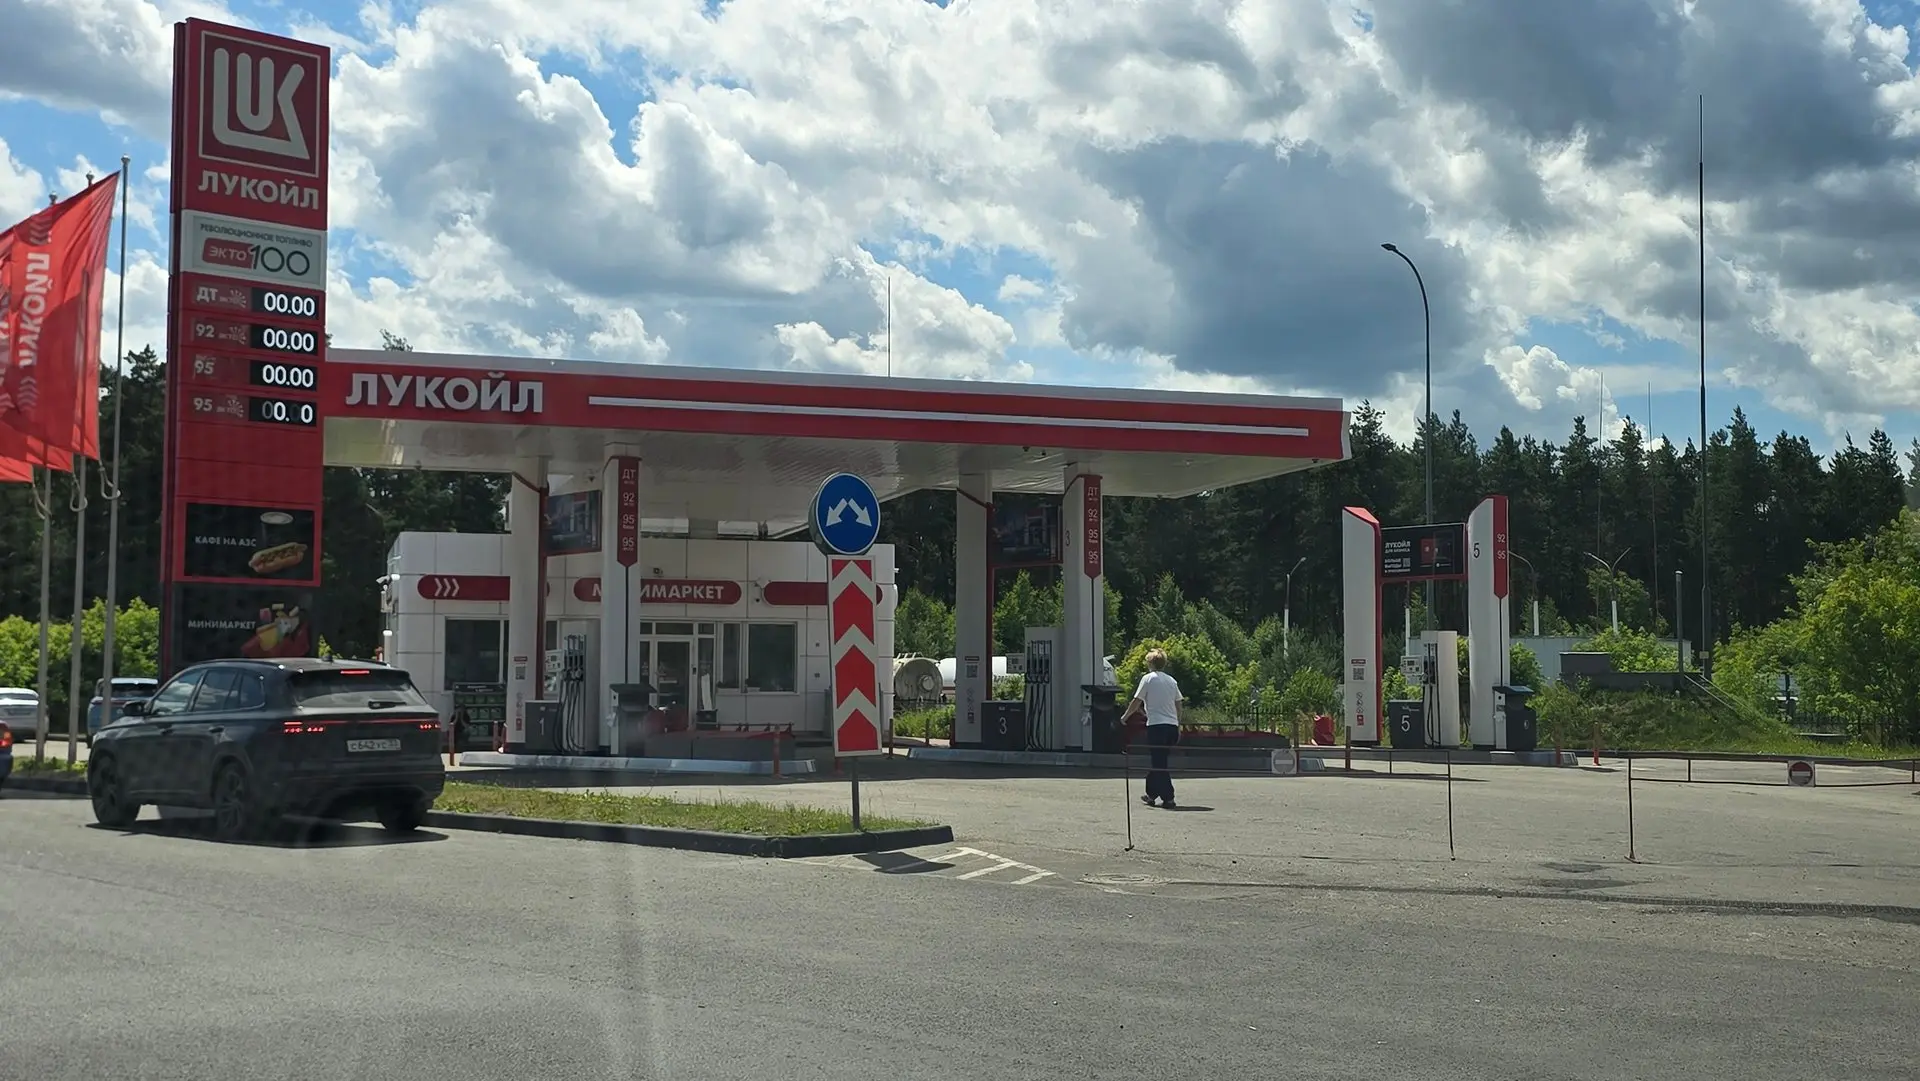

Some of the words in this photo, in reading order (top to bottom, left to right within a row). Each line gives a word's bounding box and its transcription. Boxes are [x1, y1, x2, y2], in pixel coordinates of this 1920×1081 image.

[198, 170, 319, 210] ЛУКОЙЛ
[200, 223, 273, 241] РЕВОЛЮЦИОННОЕ
[275, 234, 313, 248] ТОПЛИВО
[209, 246, 247, 261] ЭКТО
[250, 245, 310, 276] 100
[196, 286, 218, 303] ДТ
[264, 292, 315, 316] 00.00
[195, 324, 215, 338] 92
[263, 328, 314, 352] 00.00
[194, 360, 214, 375] 95
[262, 364, 314, 388] 00.00
[345, 371, 543, 413] ЛУКОЙЛ
[193, 398, 213, 412] 95
[622, 469, 636, 480] ДТ
[623, 493, 635, 503] 92
[622, 515, 635, 525] 95
[1088, 508, 1098, 518] 92
[195, 536, 221, 545] КАФЕ
[223, 537, 237, 545] НА
[239, 538, 257, 547] АЗС
[1088, 529, 1099, 539] 95
[1497, 533, 1506, 543] 92
[622, 538, 635, 548] 95
[1474, 542, 1480, 559] 5
[1497, 550, 1506, 560] 95
[592, 583, 724, 600] МИМАРКЕТ
[188, 620, 256, 630] МИНИМАРКЕТ
[538, 718, 545, 736] 1
[999, 716, 1008, 735] 3
[1401, 714, 1410, 732] 5
